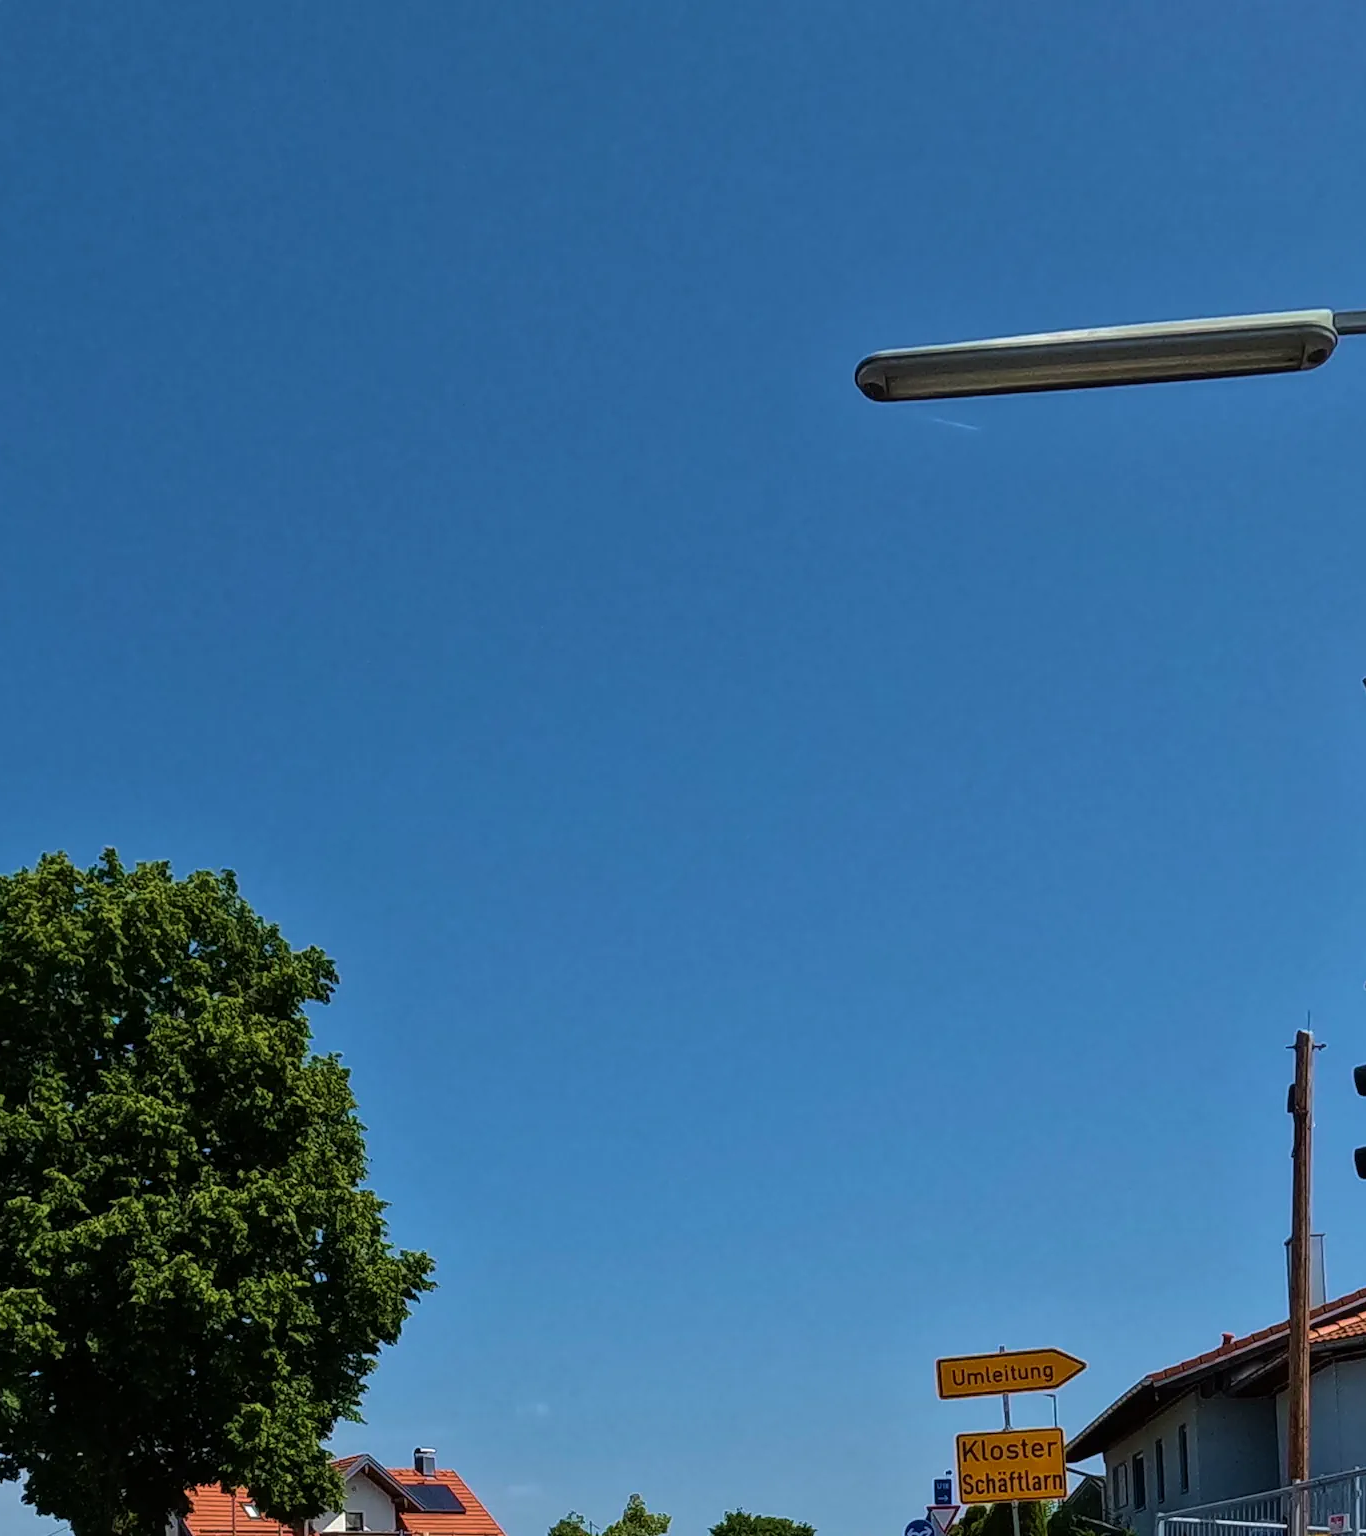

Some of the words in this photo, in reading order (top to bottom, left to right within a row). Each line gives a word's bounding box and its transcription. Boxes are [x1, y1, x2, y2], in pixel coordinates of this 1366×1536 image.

[952, 1365, 1054, 1386] Umleitung
[962, 1439, 1058, 1463] Kloster
[962, 1470, 1063, 1496] Schäftlarn
